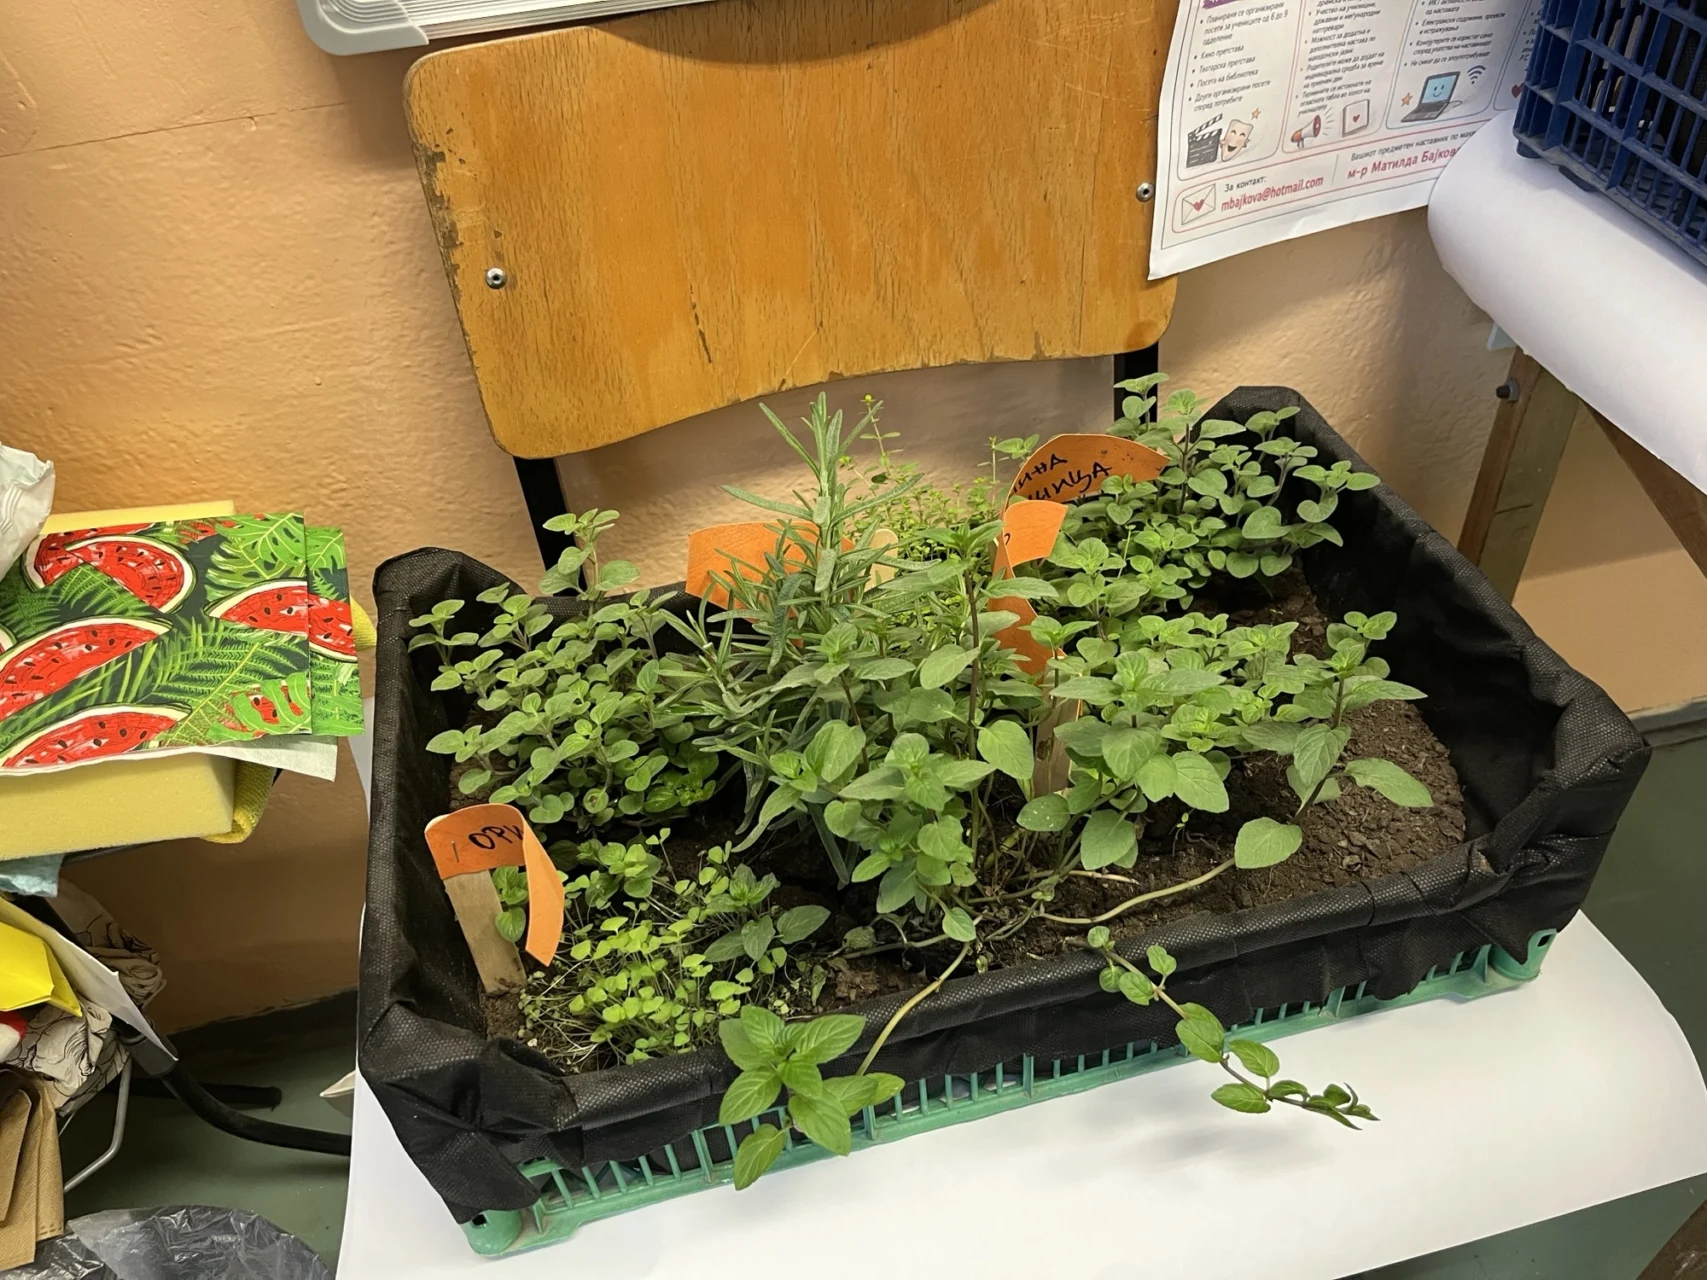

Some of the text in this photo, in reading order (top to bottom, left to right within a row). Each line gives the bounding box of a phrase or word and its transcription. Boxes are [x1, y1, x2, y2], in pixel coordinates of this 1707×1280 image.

[1204, 25, 1223, 34] посети
[1232, 18, 1261, 30] учениците
[1271, 12, 1275, 20] 6
[1206, 12, 1237, 23] Планирани
[1246, 3, 1284, 16] организирани
[1201, 46, 1244, 59] Кино претстава
[1200, 57, 1256, 73] Театарска претстава
[1197, 79, 1216, 87] Посета
[1226, 69, 1258, 81] библиотека
[1195, 80, 1271, 103] Други организирани посети
[1194, 96, 1243, 112] според потребите
[1351, 150, 1377, 161] Вашиот
[1378, 142, 1414, 155] предметен
[1415, 135, 1449, 147] наставник
[1347, 147, 1461, 179] м-р Матилда Бајков
[1221, 177, 1324, 212] mbajkova@hotmail.com
[1224, 176, 1267, 192] За контакт:
[1013, 453, 1068, 493] ИНА
